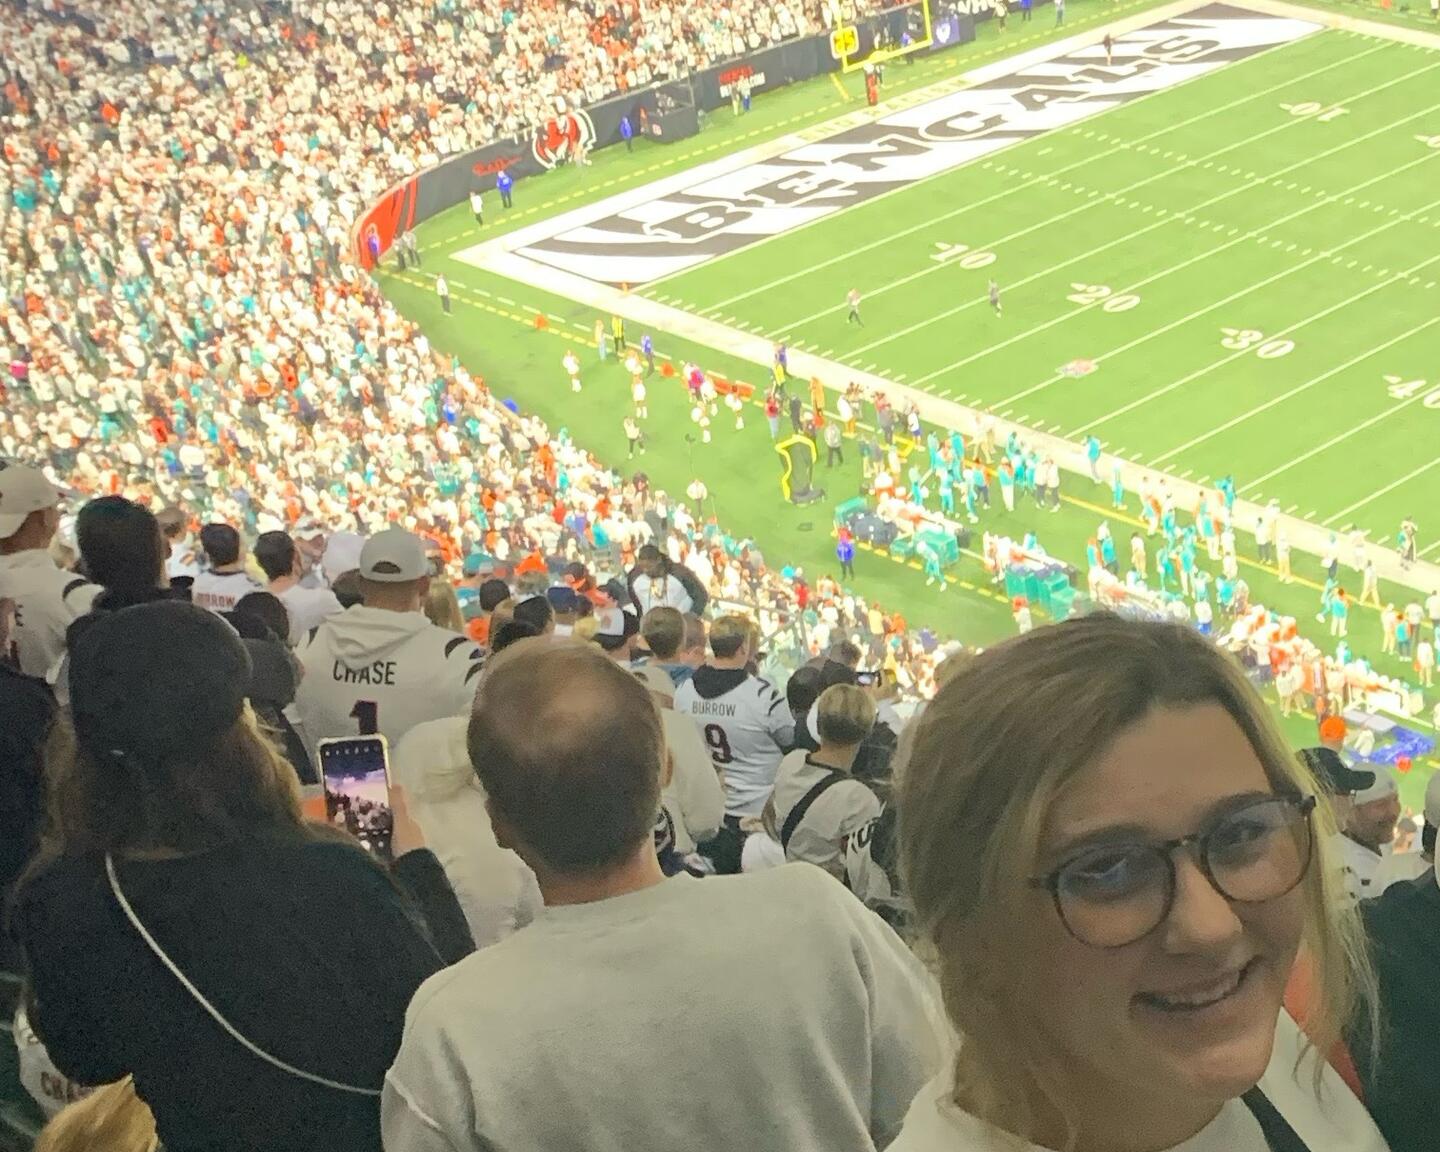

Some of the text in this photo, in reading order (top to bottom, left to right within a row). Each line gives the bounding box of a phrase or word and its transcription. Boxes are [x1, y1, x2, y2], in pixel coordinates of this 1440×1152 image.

[645, 35, 1222, 244] BENGALS
[1220, 329, 1296, 359] 30
[333, 659, 397, 685] CHASE
[692, 701, 736, 718] BURROW
[704, 723, 733, 764] 9
